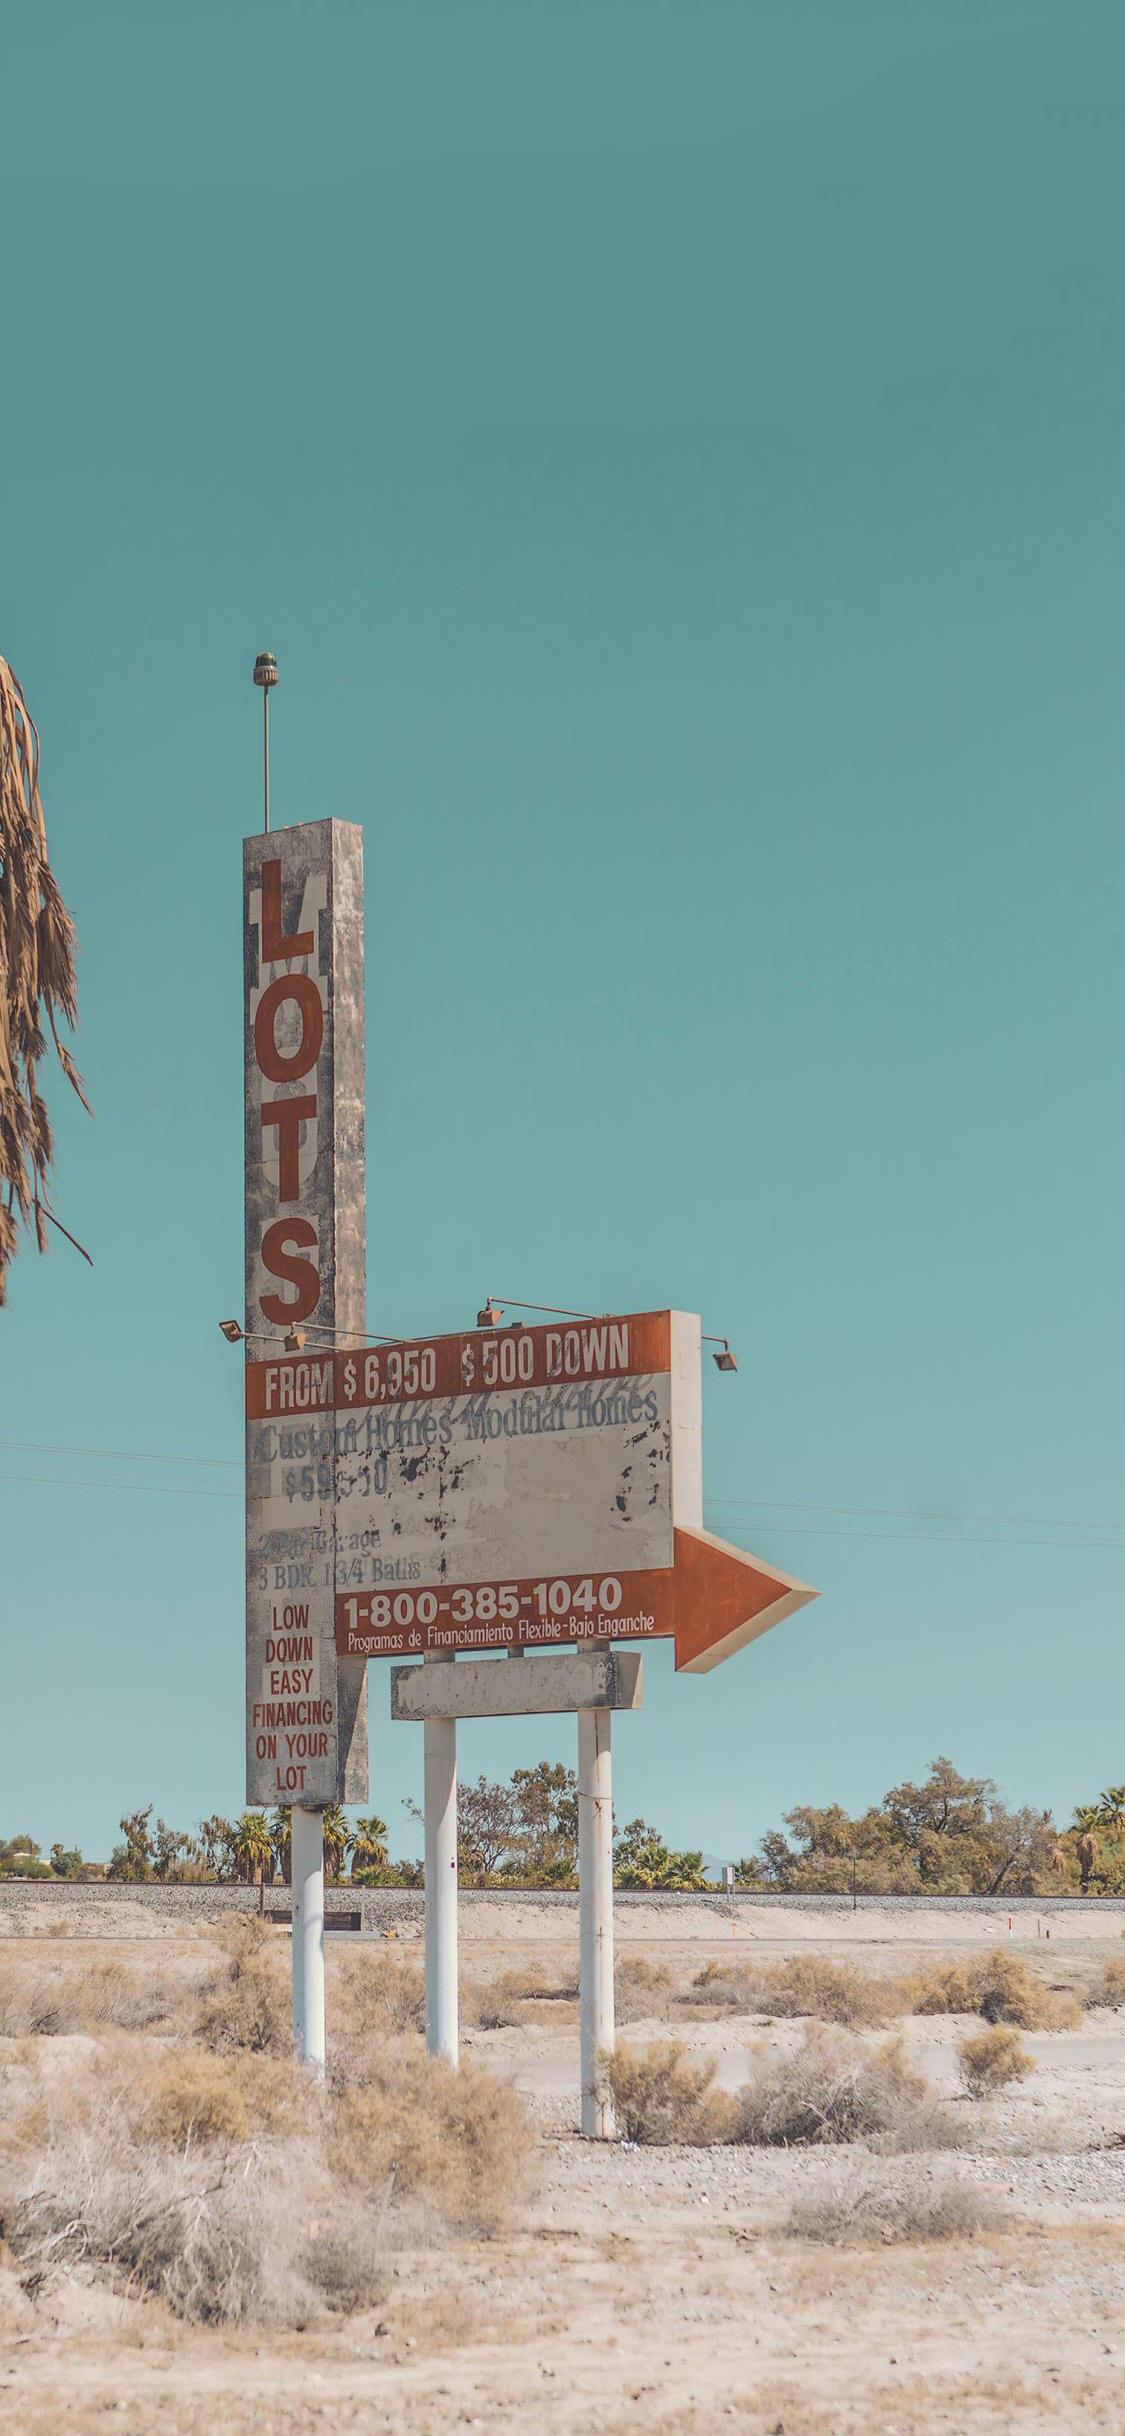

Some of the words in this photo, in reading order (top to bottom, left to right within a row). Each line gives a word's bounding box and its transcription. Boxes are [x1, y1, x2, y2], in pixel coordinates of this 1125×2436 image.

[254, 858, 323, 1326] LOTS
[265, 1360, 334, 1410] FROM
[546, 1323, 629, 1377] DOWN
[366, 1412, 452, 1452] Homes
[465, 1395, 566, 1439] Modular
[576, 1388, 658, 1428] Homes
[258, 1564, 269, 1591] 3
[273, 1563, 316, 1590] BDR
[344, 1576, 623, 1629] 1-800-385-1040
[272, 1603, 310, 1631] LOW
[348, 1632, 403, 1653] Programas
[408, 1628, 421, 1647] de
[427, 1622, 513, 1647] Financiamiento
[597, 1611, 655, 1637] Enganche
[265, 1636, 313, 1664] DOWN
[270, 1668, 314, 1695] EASY
[252, 1699, 333, 1728] FINANCING
[255, 1734, 277, 1759] ON
[285, 1731, 328, 1758] YOUR
[275, 1765, 307, 1791] LOT
